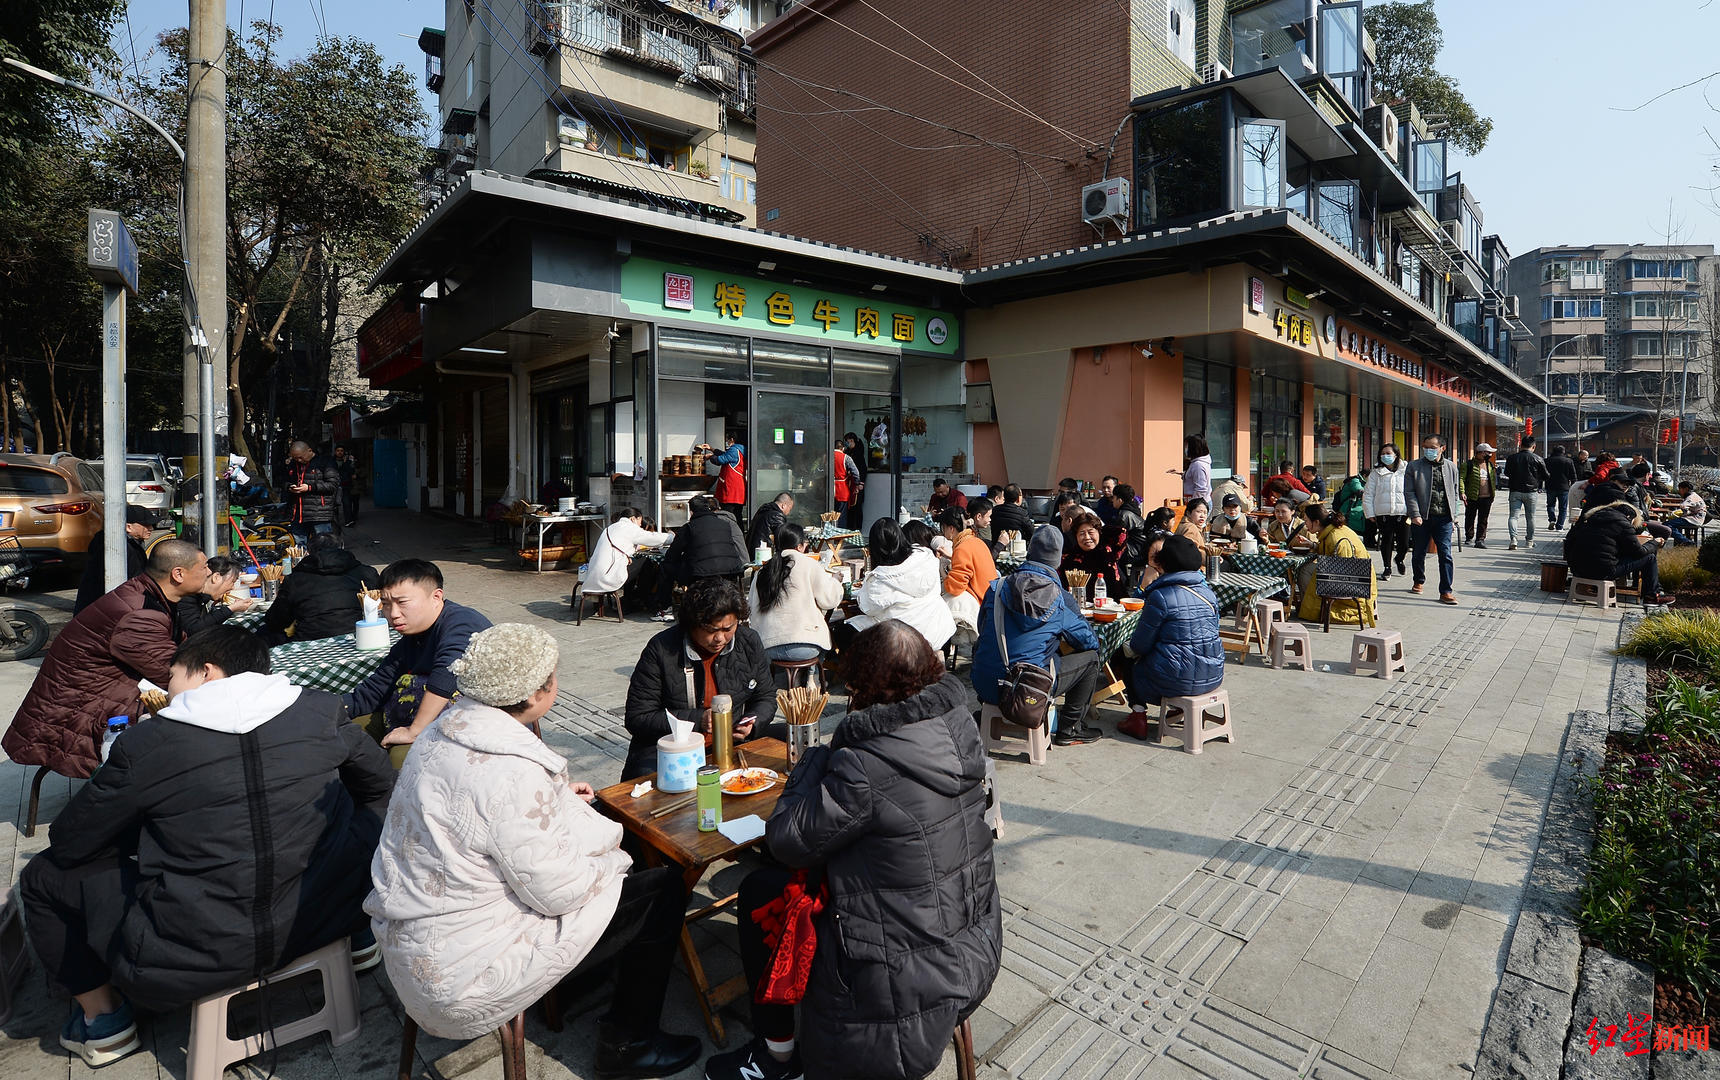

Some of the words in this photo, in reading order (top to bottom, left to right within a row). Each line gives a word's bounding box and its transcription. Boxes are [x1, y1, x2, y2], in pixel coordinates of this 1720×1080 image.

[714, 281, 915, 342] 特色牛肉面
[1276, 308, 1313, 345] 牛肉面
[109, 322, 119, 348] 成都公安
[739, 1062, 765, 1080] N
